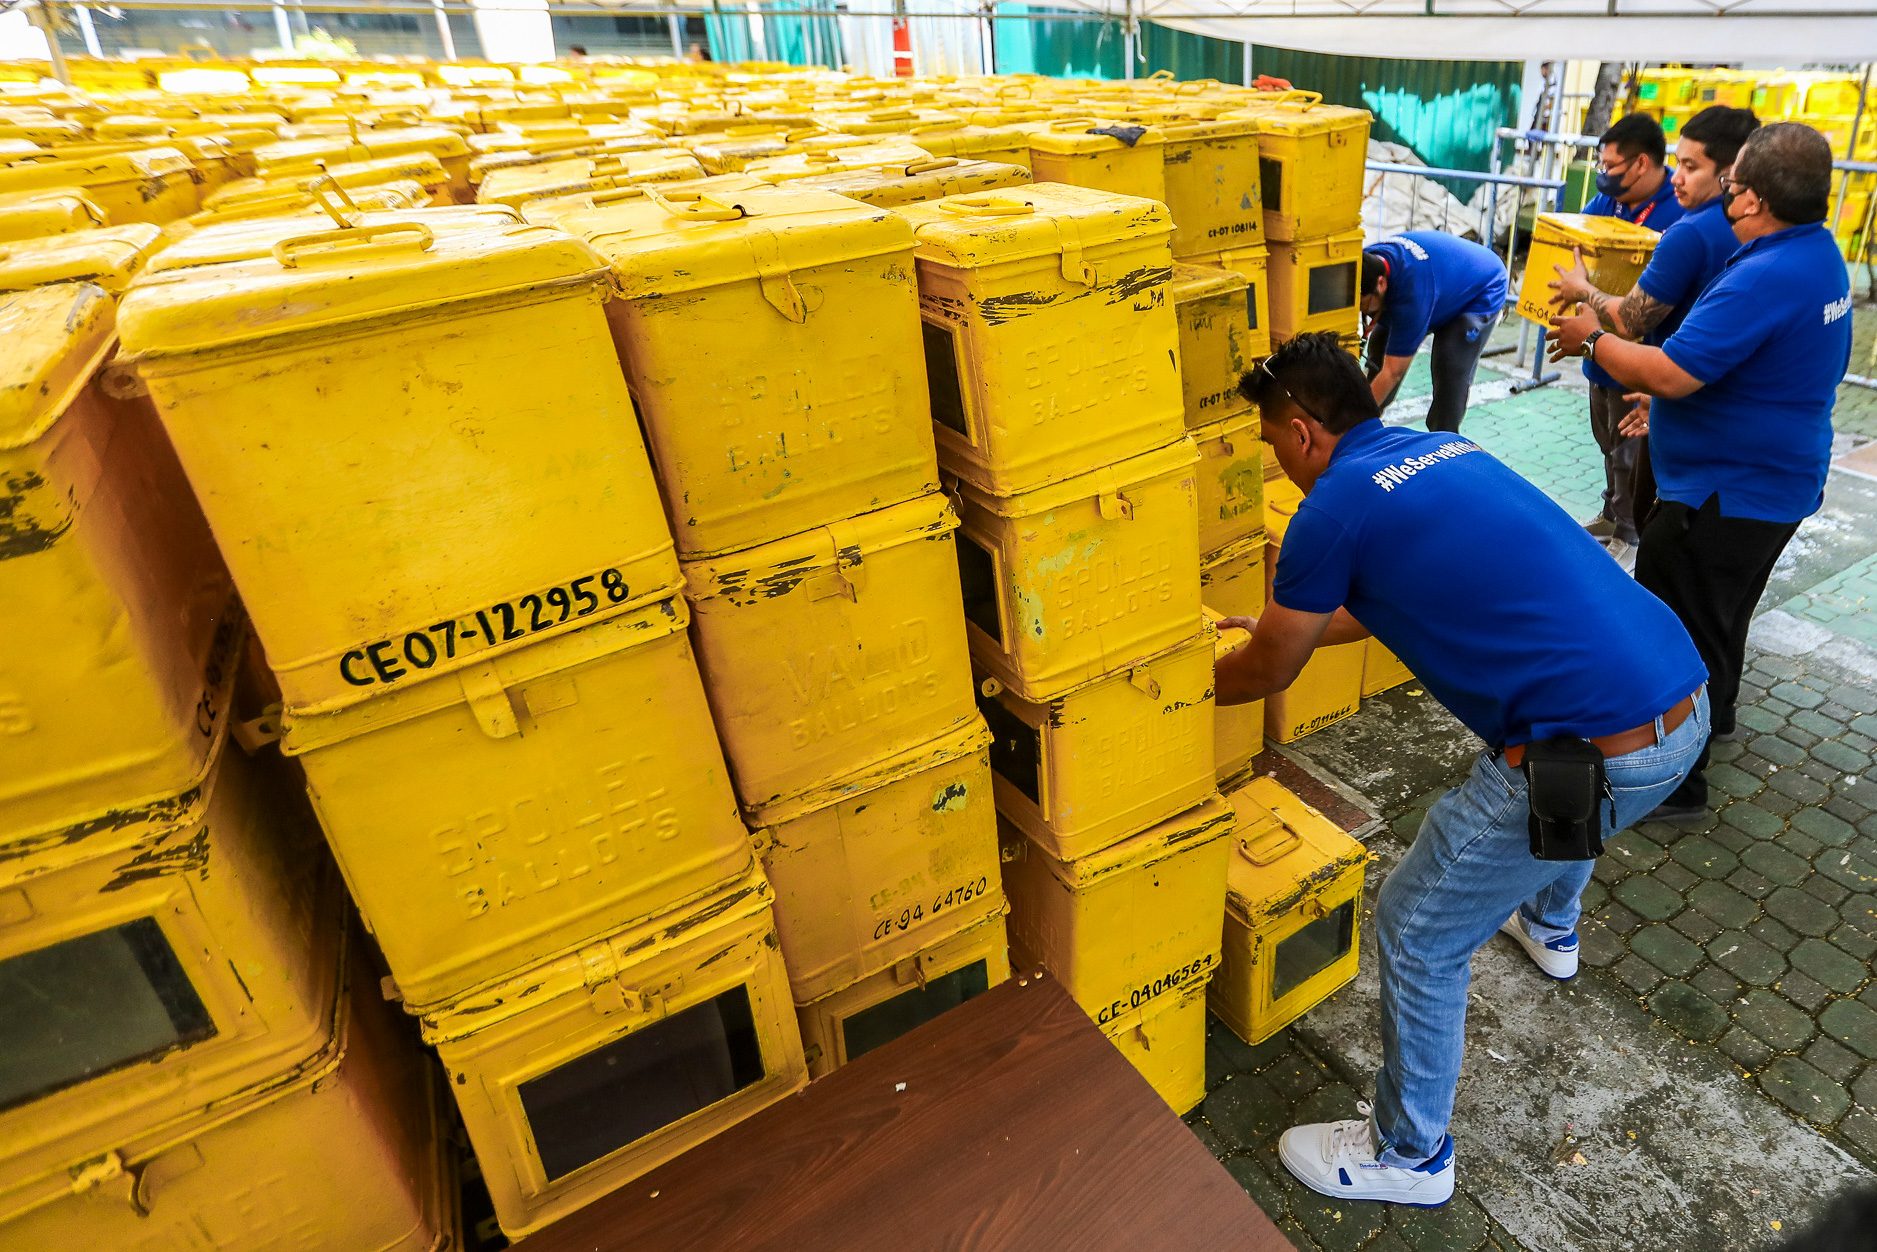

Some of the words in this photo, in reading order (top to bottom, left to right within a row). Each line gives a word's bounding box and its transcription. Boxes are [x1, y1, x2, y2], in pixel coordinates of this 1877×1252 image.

[1208, 226, 1229, 238] CE-07
[1023, 322, 1146, 390] SPOILED
[1028, 366, 1149, 426] BALLOTS
[725, 407, 892, 472] BALLOTS
[1056, 539, 1172, 610] SPOILED
[339, 567, 630, 686] CE07-122958
[1062, 580, 1173, 641] BALLOTS
[780, 616, 932, 707] VALID
[789, 670, 940, 752] BALLOTS
[456, 807, 682, 922] BALLOTS
[932, 876, 988, 914] 64760
